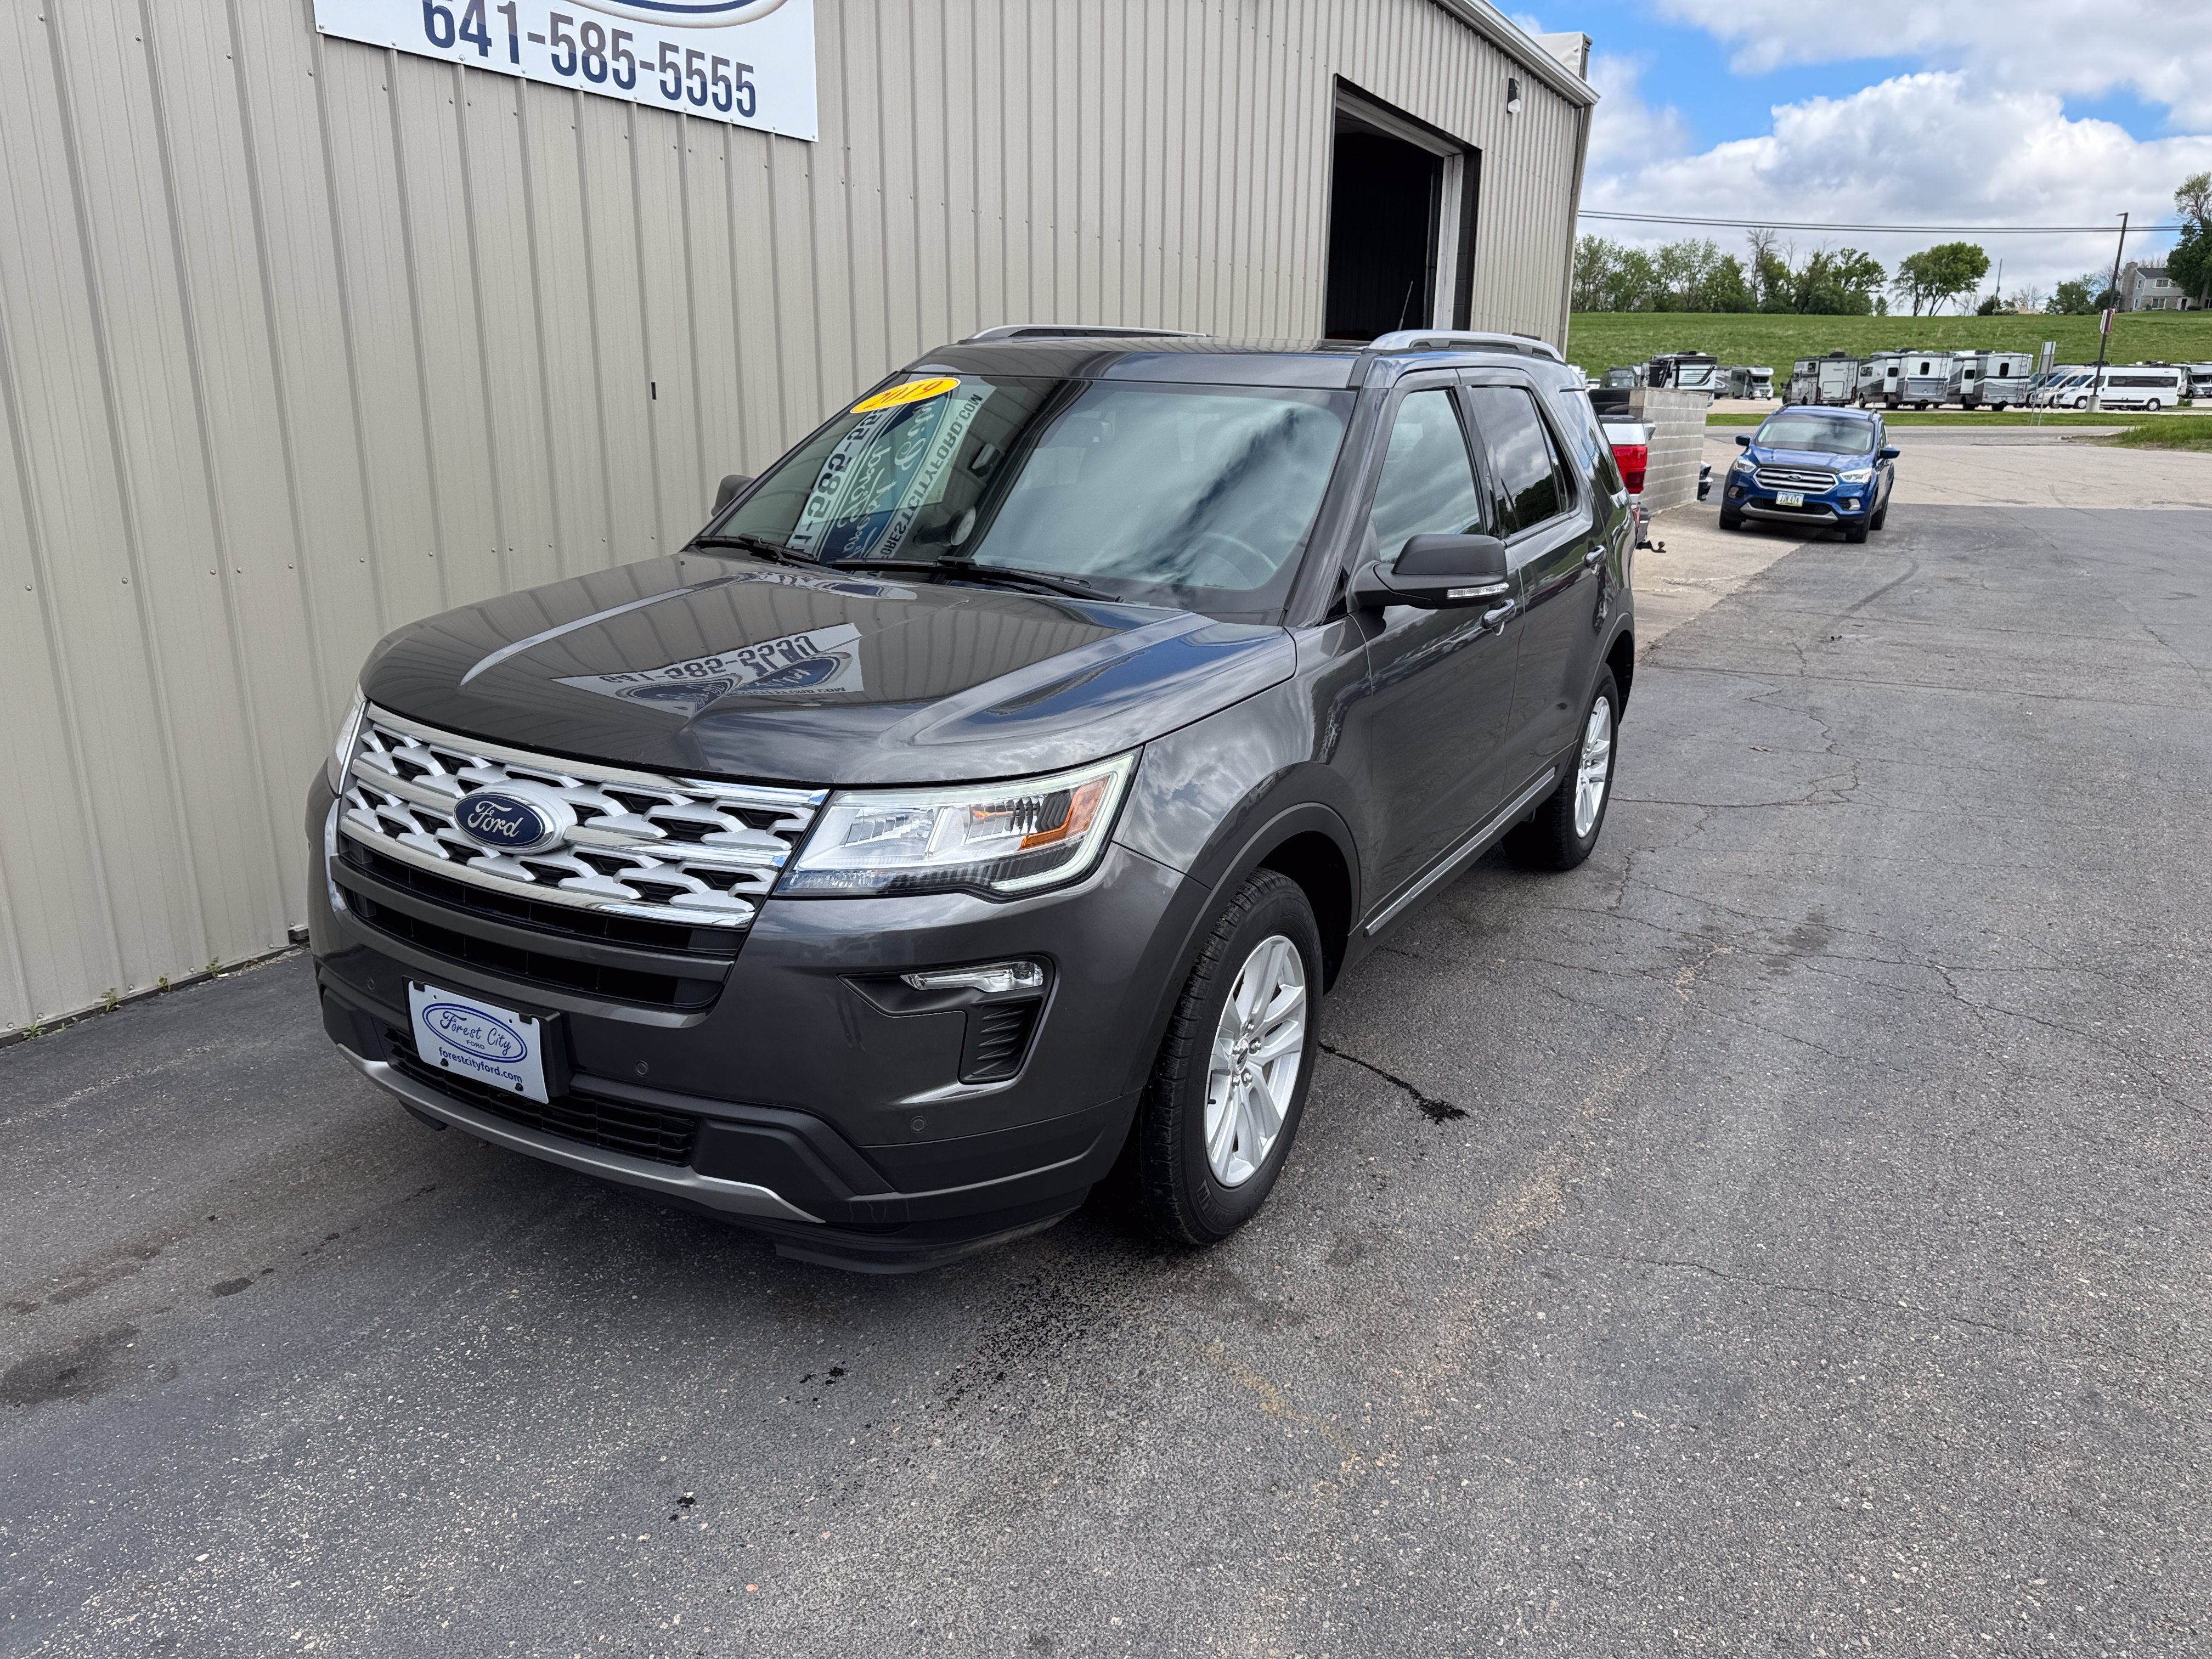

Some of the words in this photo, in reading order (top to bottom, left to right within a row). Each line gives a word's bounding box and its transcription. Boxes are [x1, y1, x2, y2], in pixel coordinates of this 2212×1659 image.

[422, 0, 756, 118] 641-585-5555
[861, 380, 944, 410] 2019
[467, 800, 524, 838] Ford
[440, 1011, 482, 1040] Forest
[487, 1028, 511, 1056] City
[466, 1040, 485, 1050] FORD
[439, 1047, 523, 1083] forestcityford.com
